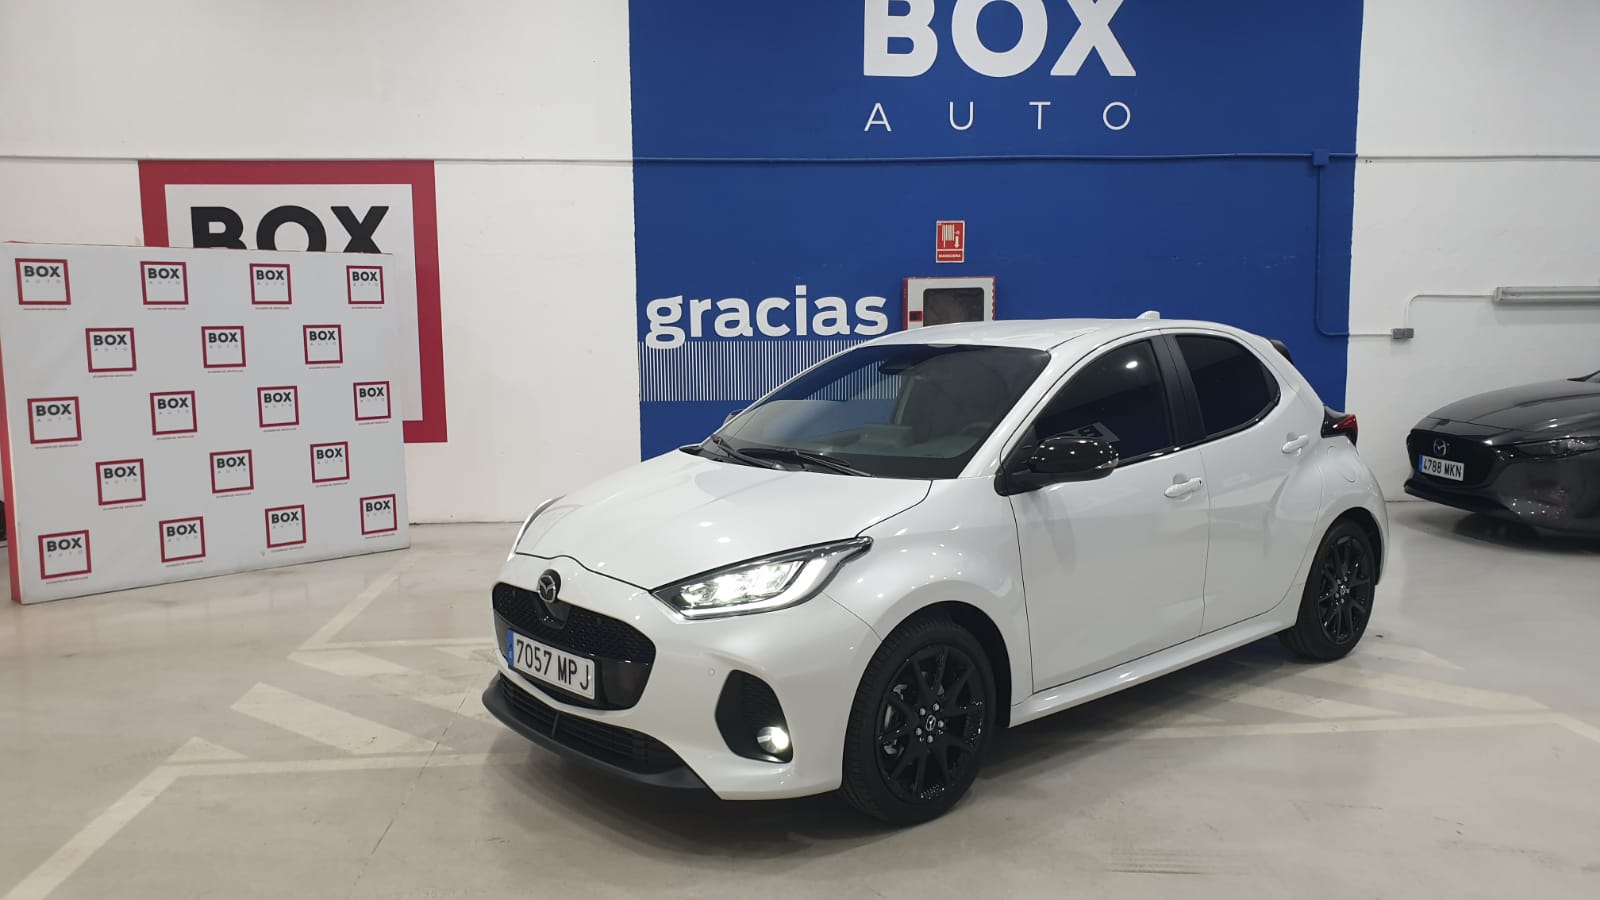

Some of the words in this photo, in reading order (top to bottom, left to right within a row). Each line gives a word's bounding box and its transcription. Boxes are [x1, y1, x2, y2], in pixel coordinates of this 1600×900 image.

[863, 0, 1137, 77] BOX
[864, 101, 1131, 131] AUTO
[190, 205, 390, 254] BOX
[24, 266, 61, 278] BOX
[148, 268, 180, 280] BOX
[256, 270, 285, 281] BOX
[353, 272, 378, 282] BOX
[645, 285, 889, 349] gracias
[94, 335, 128, 346] BOX
[209, 333, 238, 344] BOX
[310, 331, 336, 341] BOX
[264, 393, 292, 404] BOX
[360, 387, 385, 398] BOX
[158, 398, 189, 410] BOX
[36, 404, 72, 417] BOX
[317, 448, 343, 460] BOX
[217, 457, 246, 469] BOX
[104, 466, 137, 480] BOX
[1444, 462, 1462, 479] MKN
[366, 501, 391, 513] BOX
[272, 511, 299, 524] BOX
[167, 524, 198, 537] BOX
[47, 538, 82, 553] BOX
[516, 639, 552, 676] 7057
[558, 655, 589, 691] MPJ
